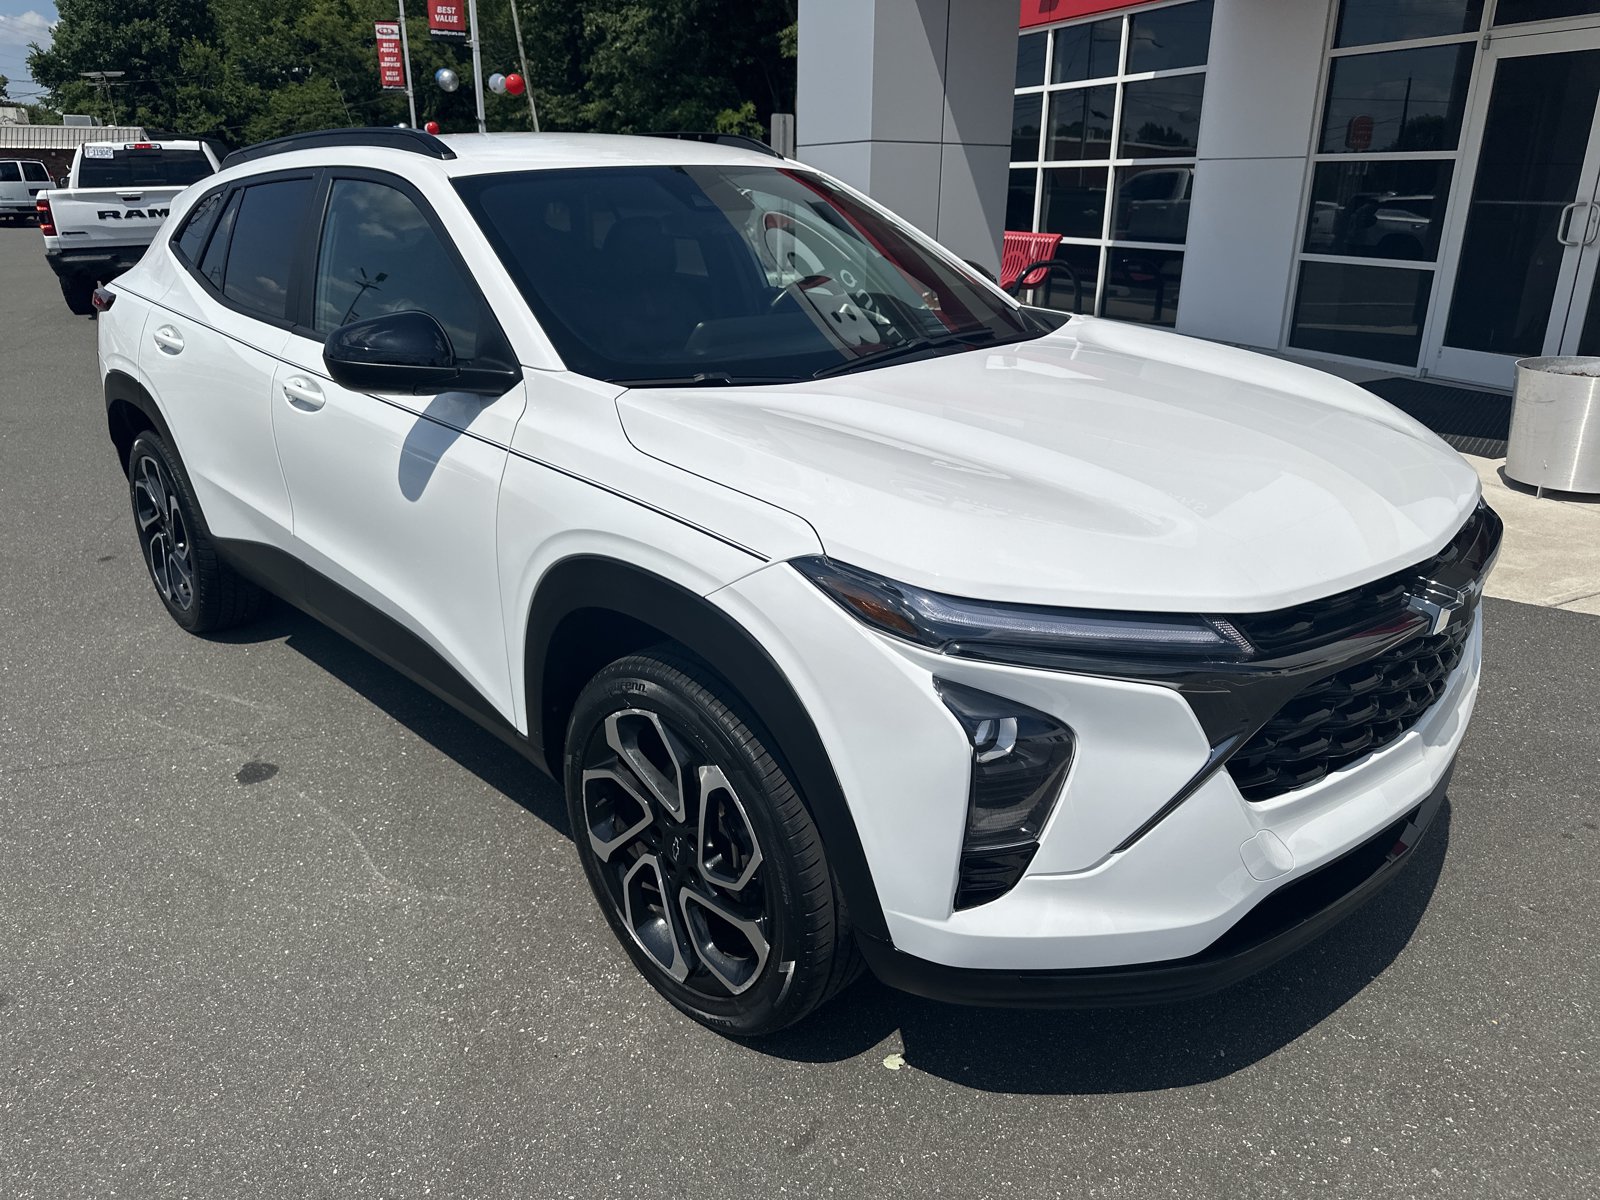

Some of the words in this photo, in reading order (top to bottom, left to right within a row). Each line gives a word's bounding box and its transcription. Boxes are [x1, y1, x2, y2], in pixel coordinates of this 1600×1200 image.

[437, 6, 456, 14] BEST
[434, 14, 458, 23] VALUE
[97, 208, 170, 220] RAM
